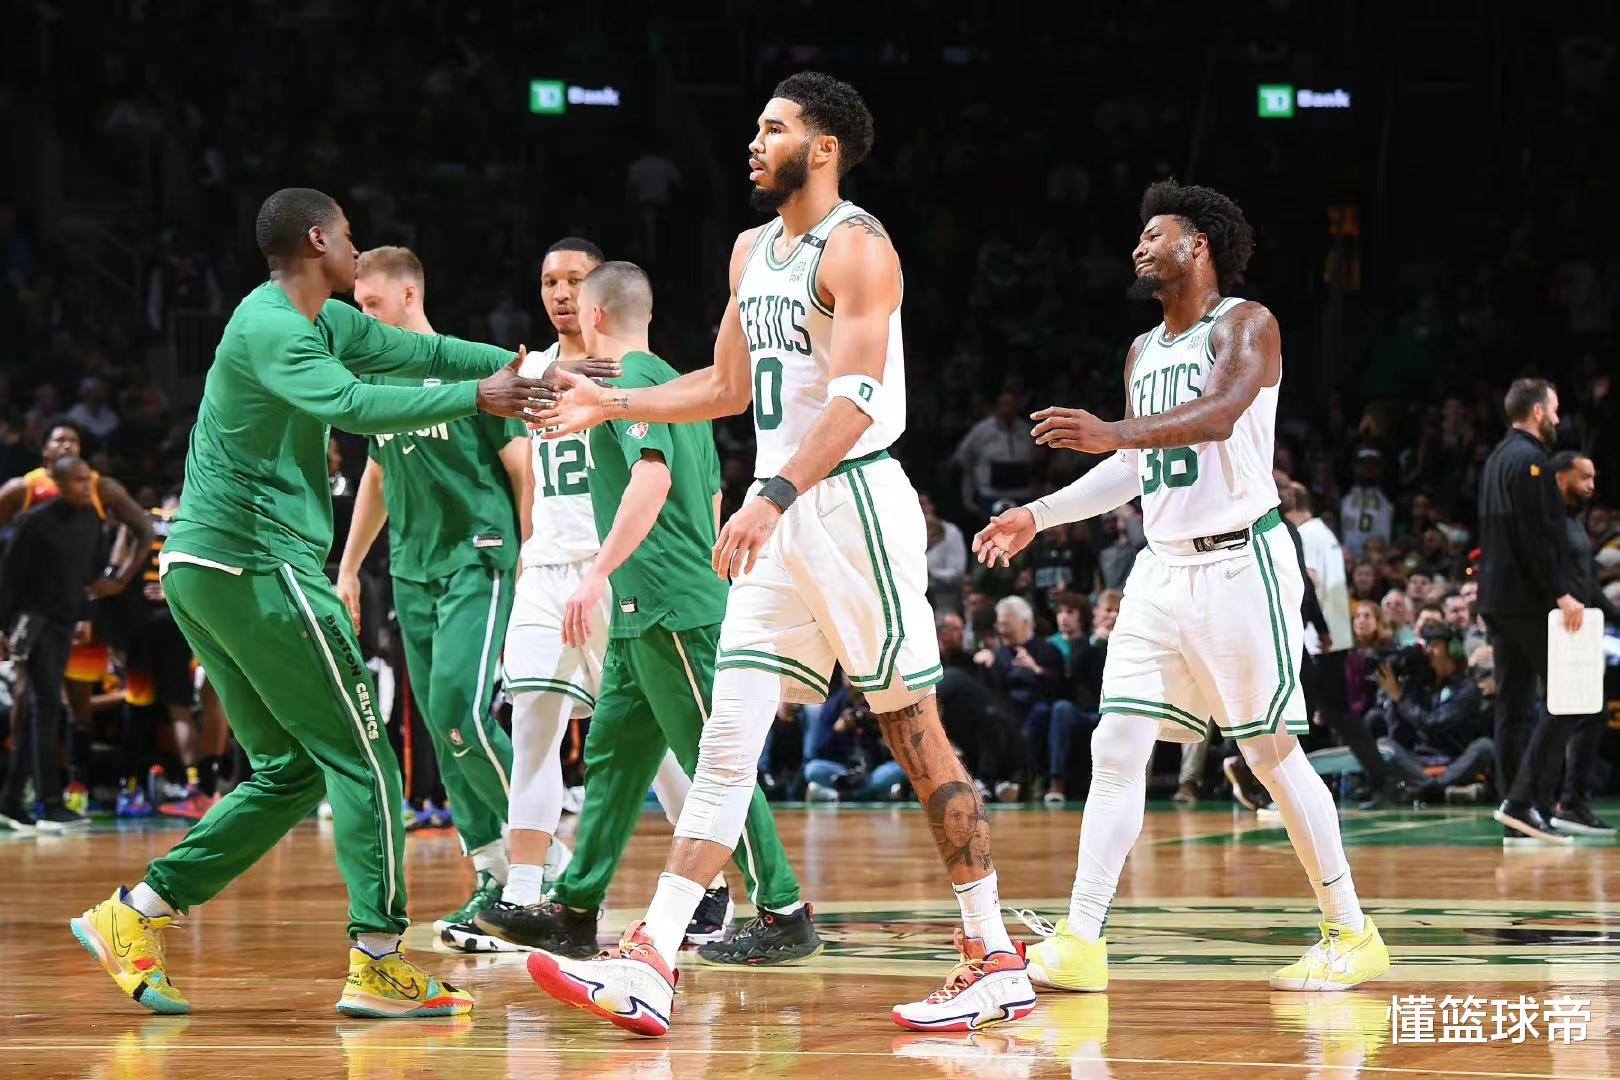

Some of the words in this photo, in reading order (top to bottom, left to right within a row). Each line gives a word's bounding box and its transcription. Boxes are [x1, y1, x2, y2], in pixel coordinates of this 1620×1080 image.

[531, 83, 565, 109] TD
[567, 85, 620, 106] Bank
[1260, 88, 1292, 113] TD
[1297, 88, 1350, 108] Bank
[755, 357, 783, 430] 0
[539, 440, 590, 497] 12
[325, 614, 361, 677] BOSTON
[355, 682, 379, 740] CELTICS
